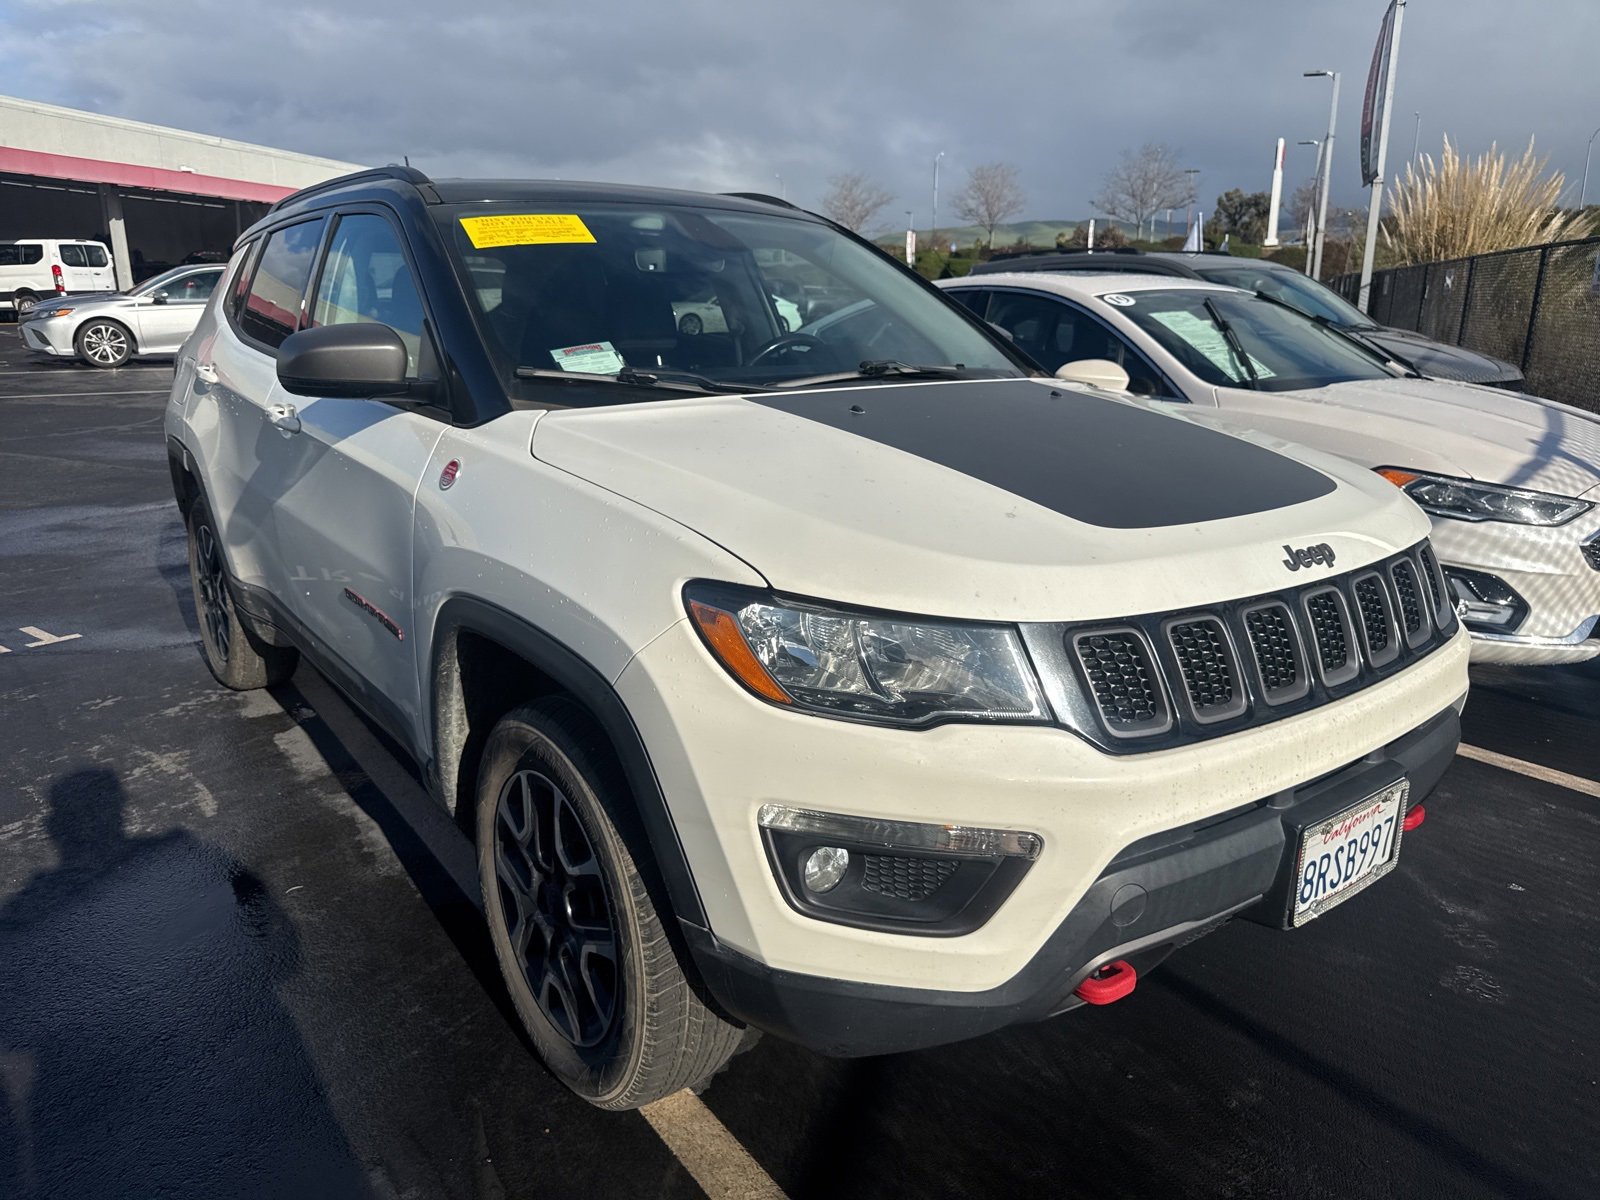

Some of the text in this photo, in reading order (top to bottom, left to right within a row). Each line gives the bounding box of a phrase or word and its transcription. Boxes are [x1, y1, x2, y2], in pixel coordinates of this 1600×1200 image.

[1282, 542, 1336, 572] Jeep
[1323, 804, 1386, 845] California
[1299, 815, 1394, 904] 8RSB997
